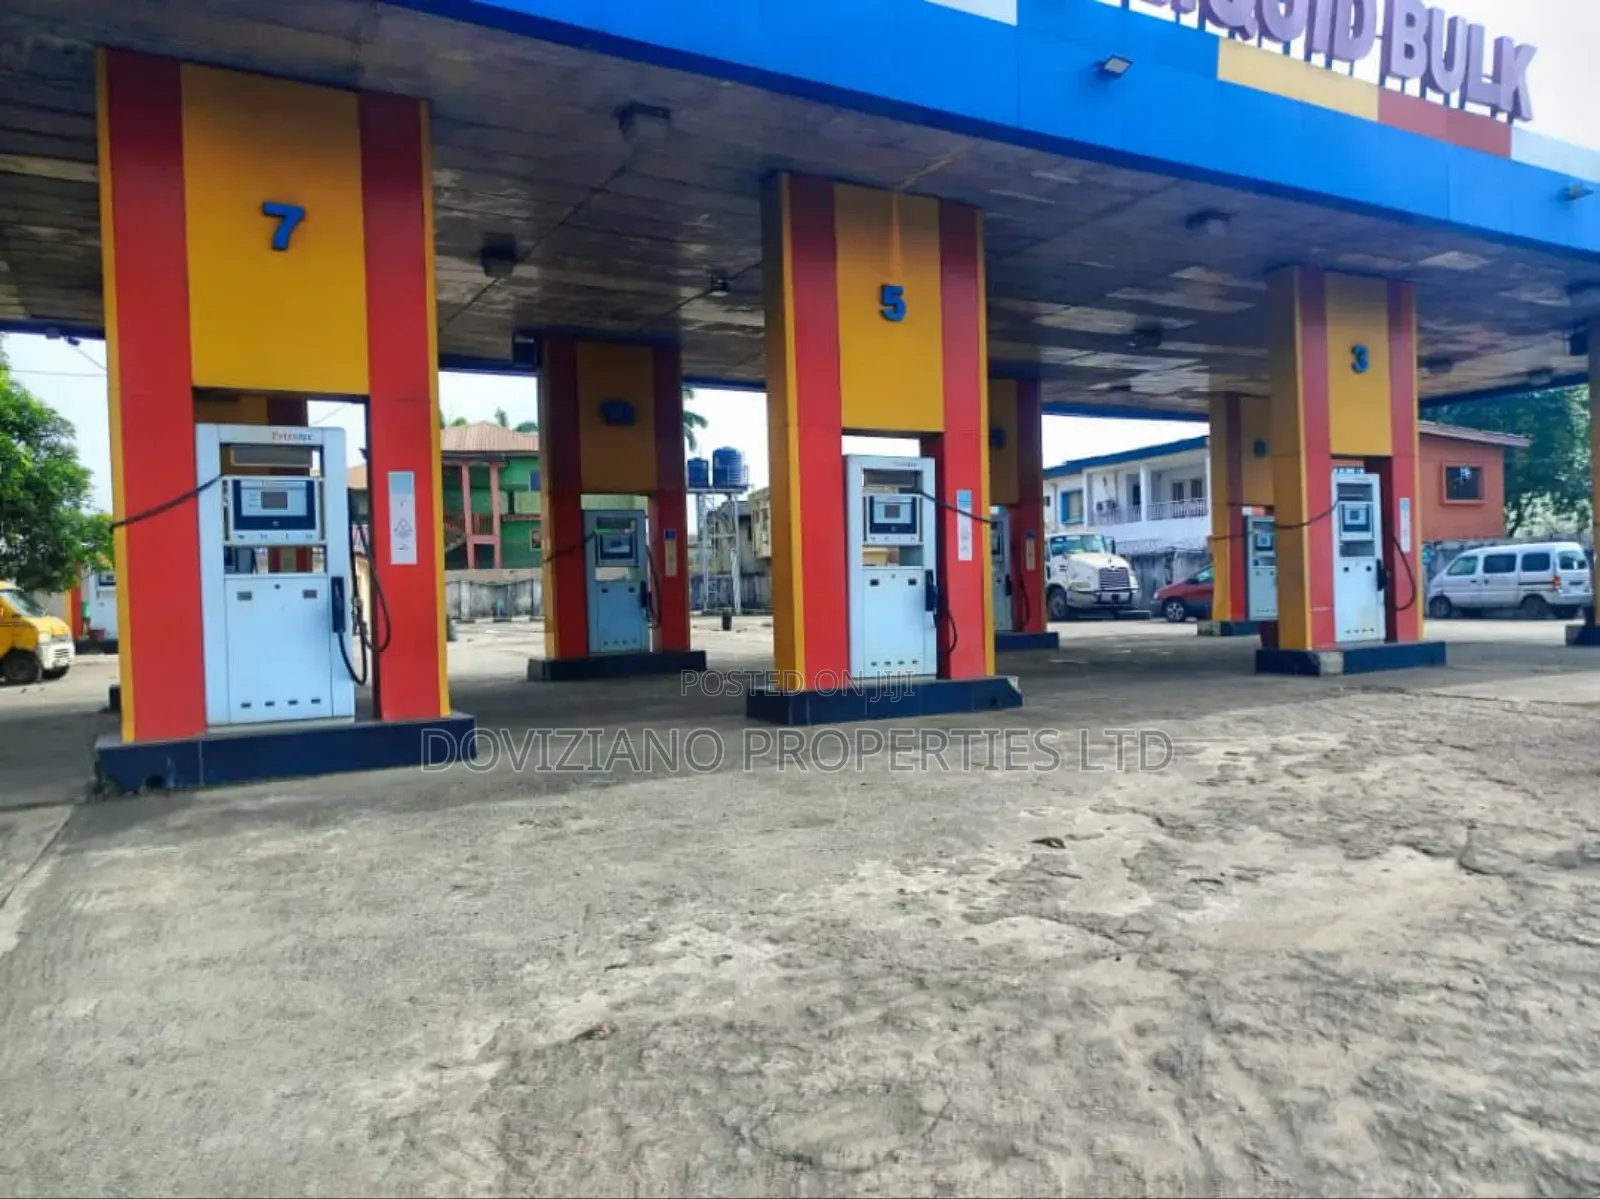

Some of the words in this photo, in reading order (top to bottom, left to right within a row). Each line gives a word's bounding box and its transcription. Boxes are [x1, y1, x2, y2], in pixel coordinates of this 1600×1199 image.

[1143, 0, 1378, 61] QUID
[1380, 0, 1537, 122] BULK
[261, 200, 305, 251] 7
[880, 284, 907, 322] 5
[1350, 344, 1369, 374] 3
